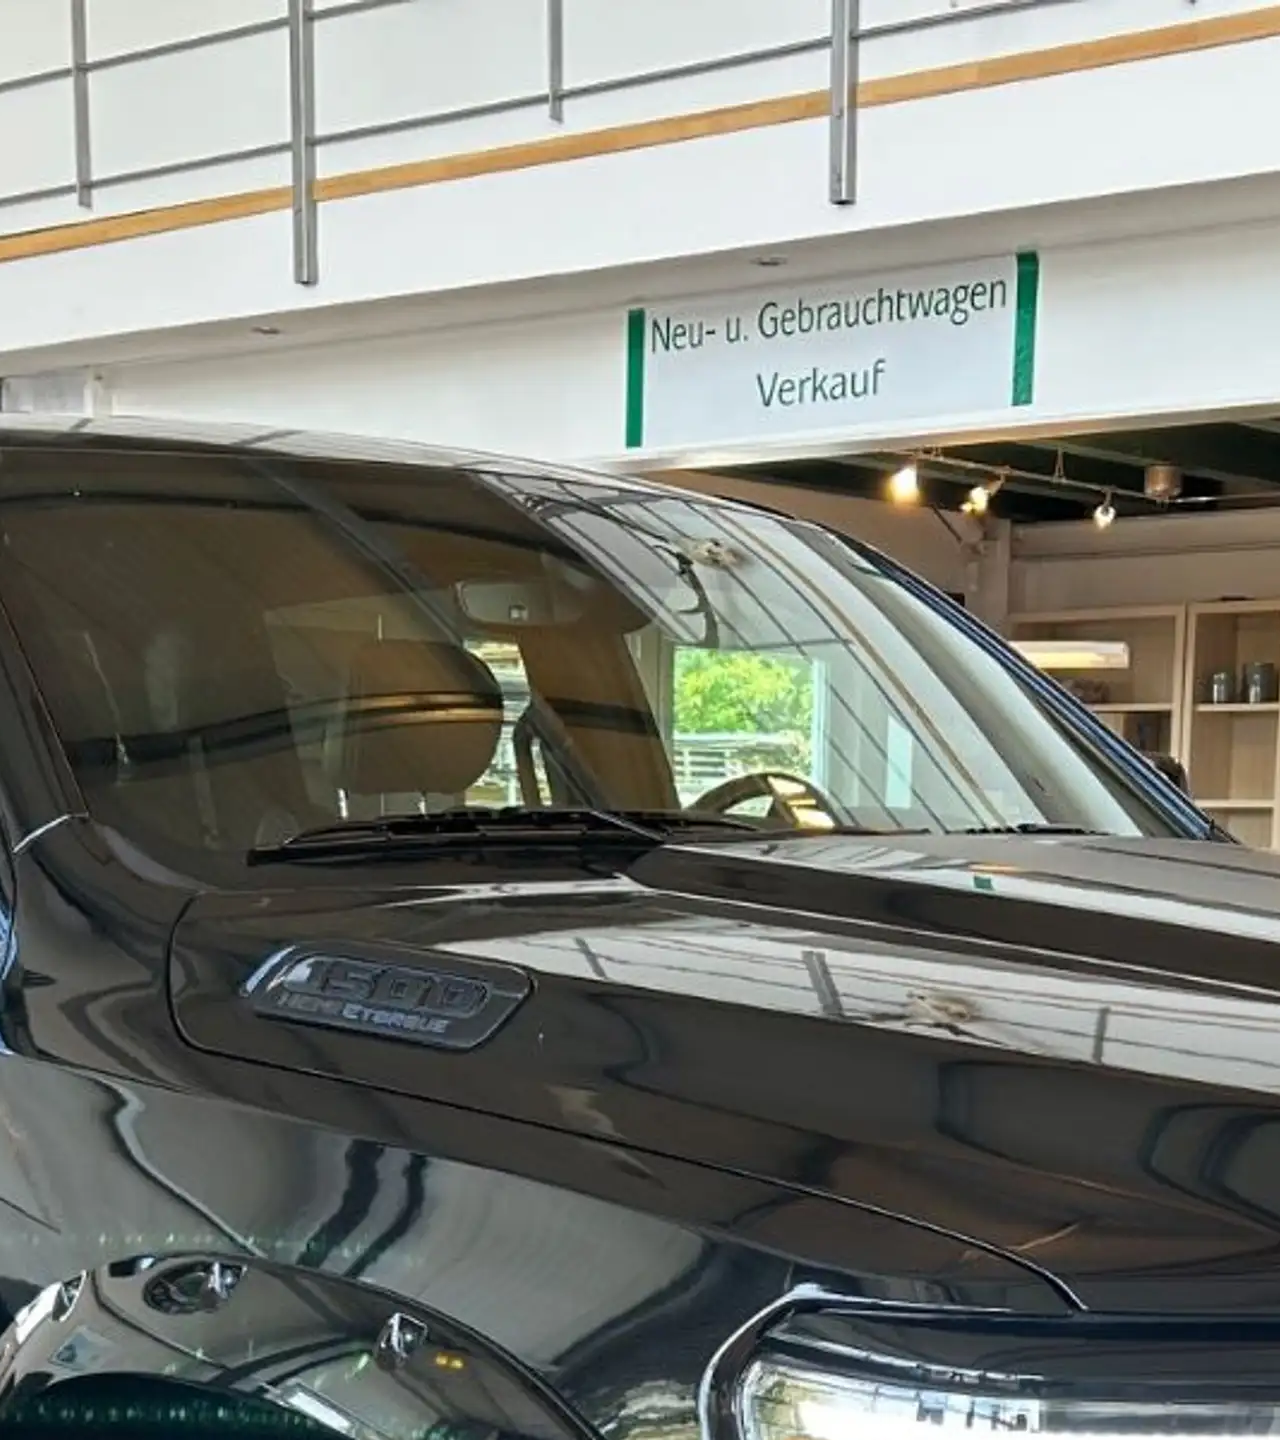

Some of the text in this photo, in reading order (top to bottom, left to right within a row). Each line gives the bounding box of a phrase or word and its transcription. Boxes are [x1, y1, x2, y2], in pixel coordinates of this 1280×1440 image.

[651, 278, 1008, 354] Neu- u. Gebrauchtwagen
[756, 358, 887, 408] Verkauf
